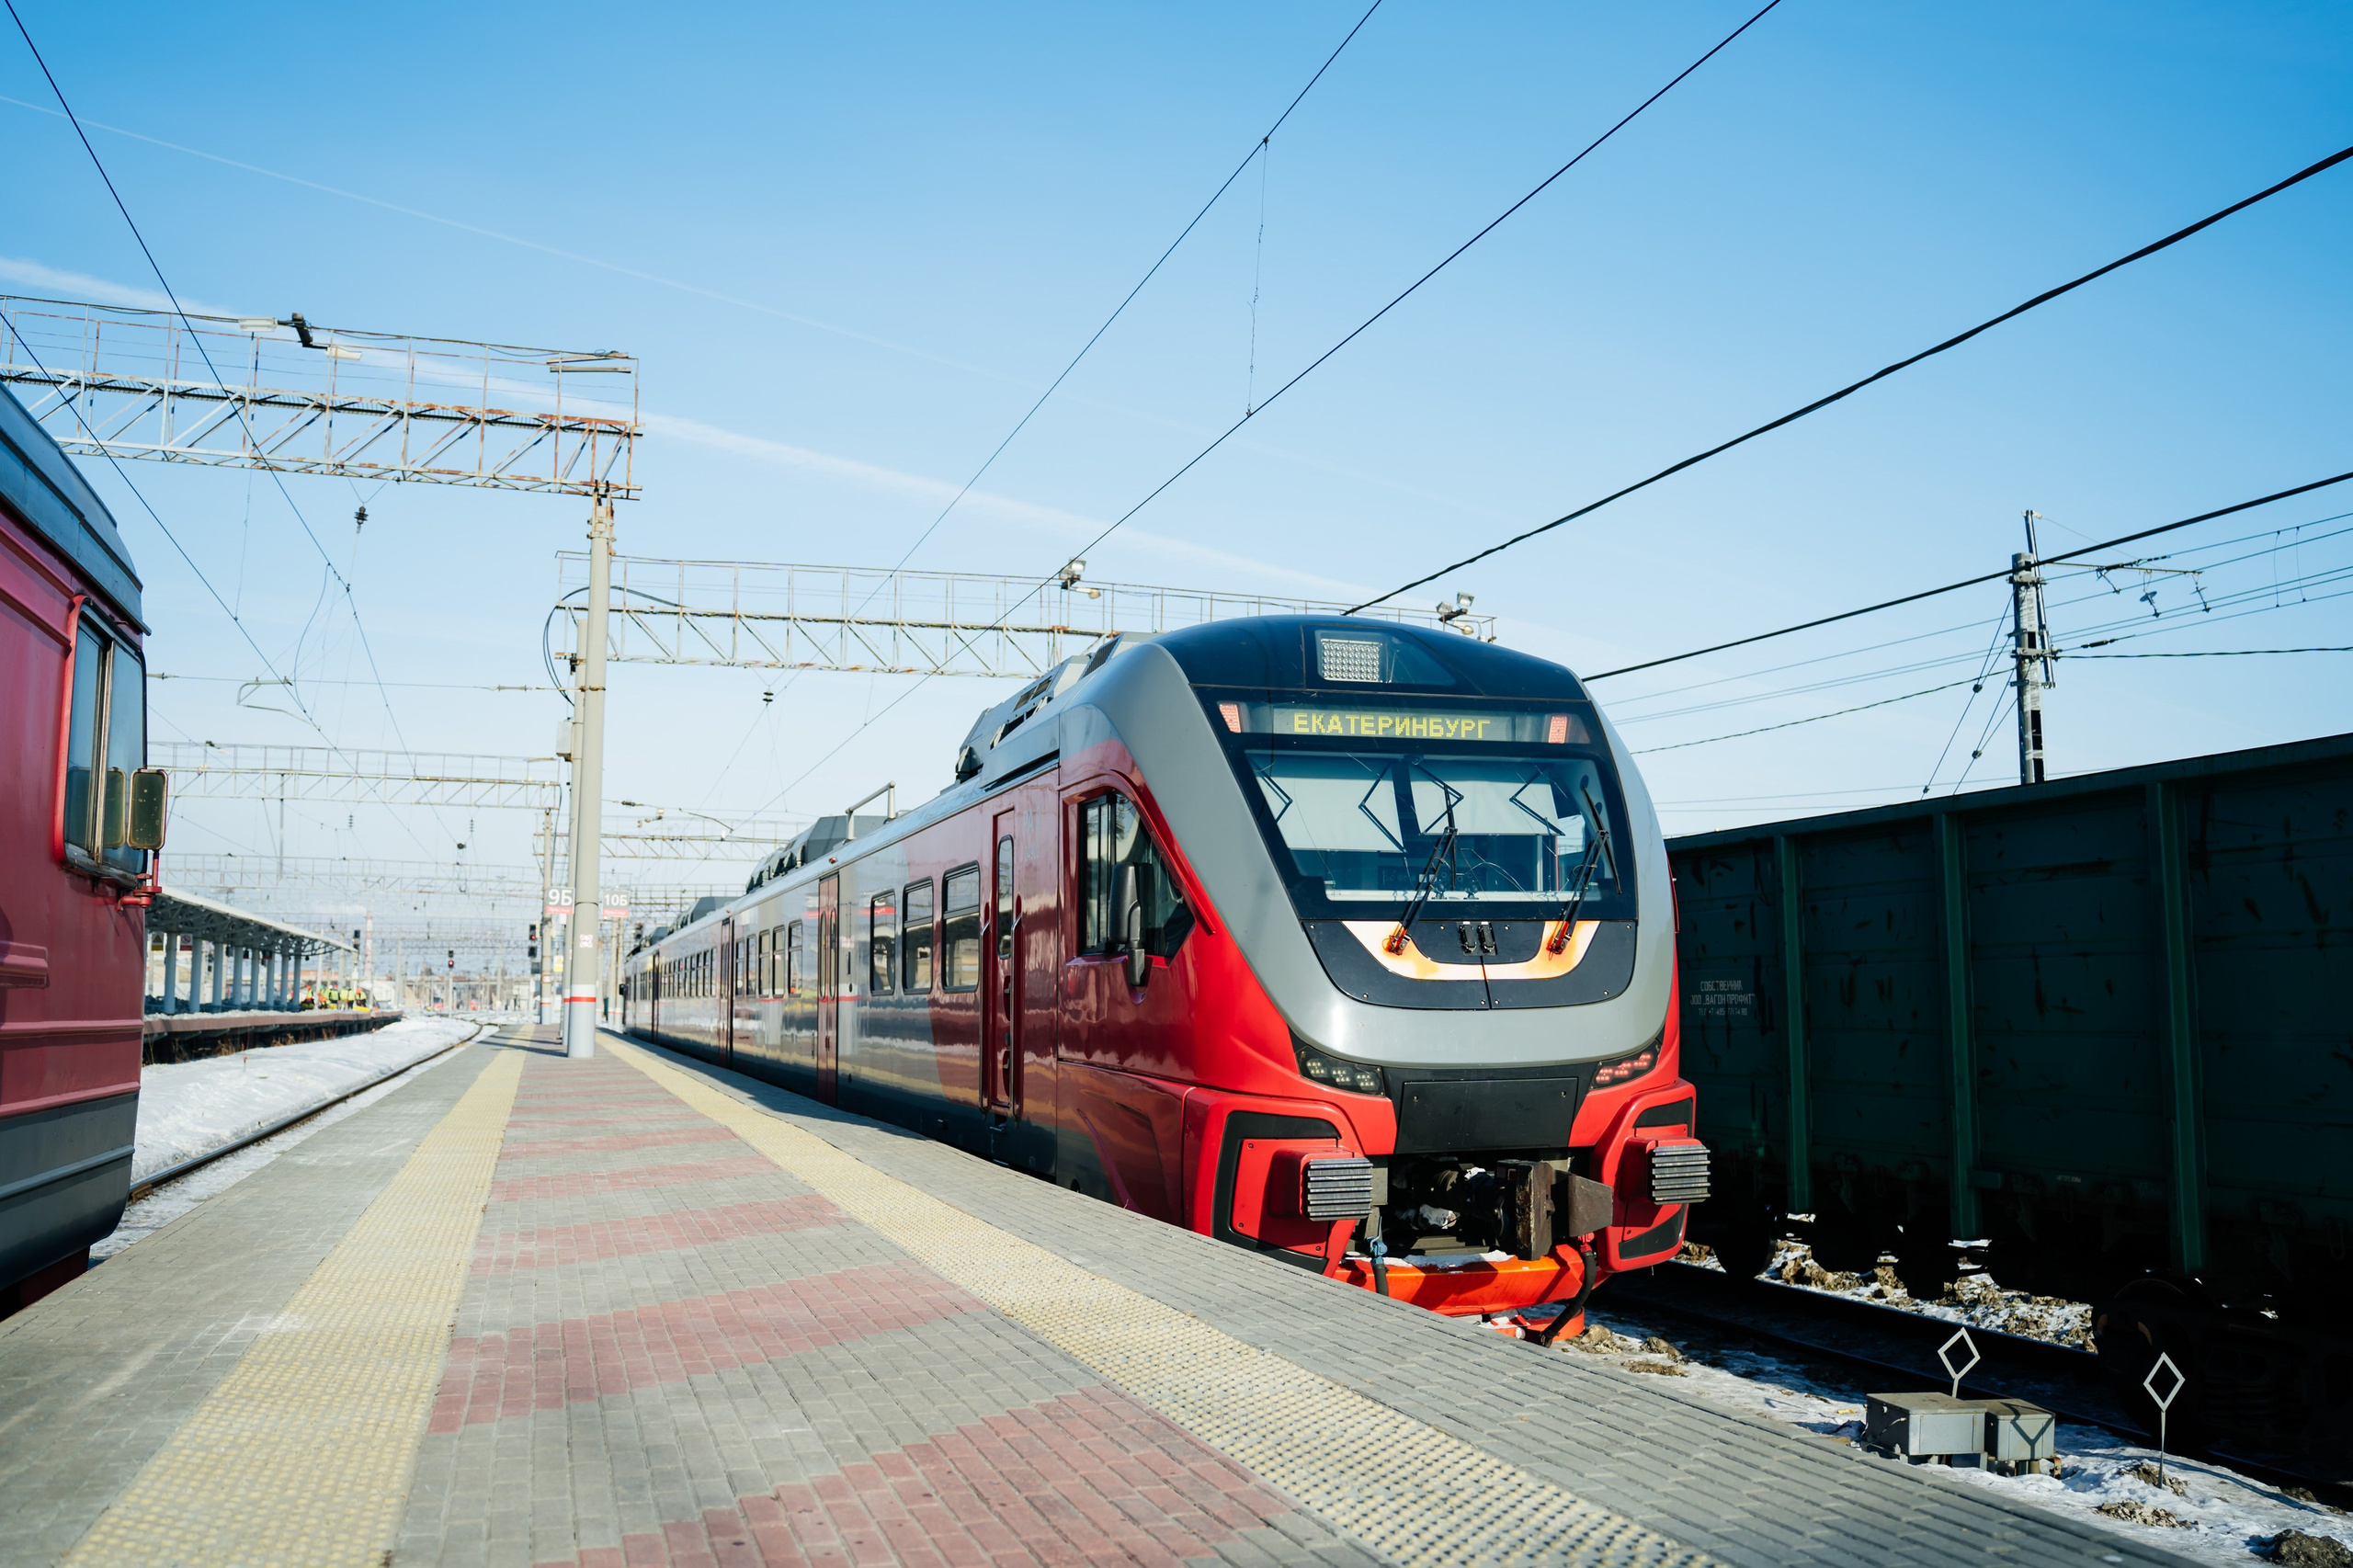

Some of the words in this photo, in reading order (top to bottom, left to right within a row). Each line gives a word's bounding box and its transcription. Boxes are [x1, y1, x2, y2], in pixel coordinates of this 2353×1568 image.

[1293, 712, 1491, 739] ЕКАТЕРИНБУРГ
[548, 888, 573, 906] 9Б
[604, 893, 628, 906] 10Б
[1699, 980, 1744, 992] СОБСТВЕННИК
